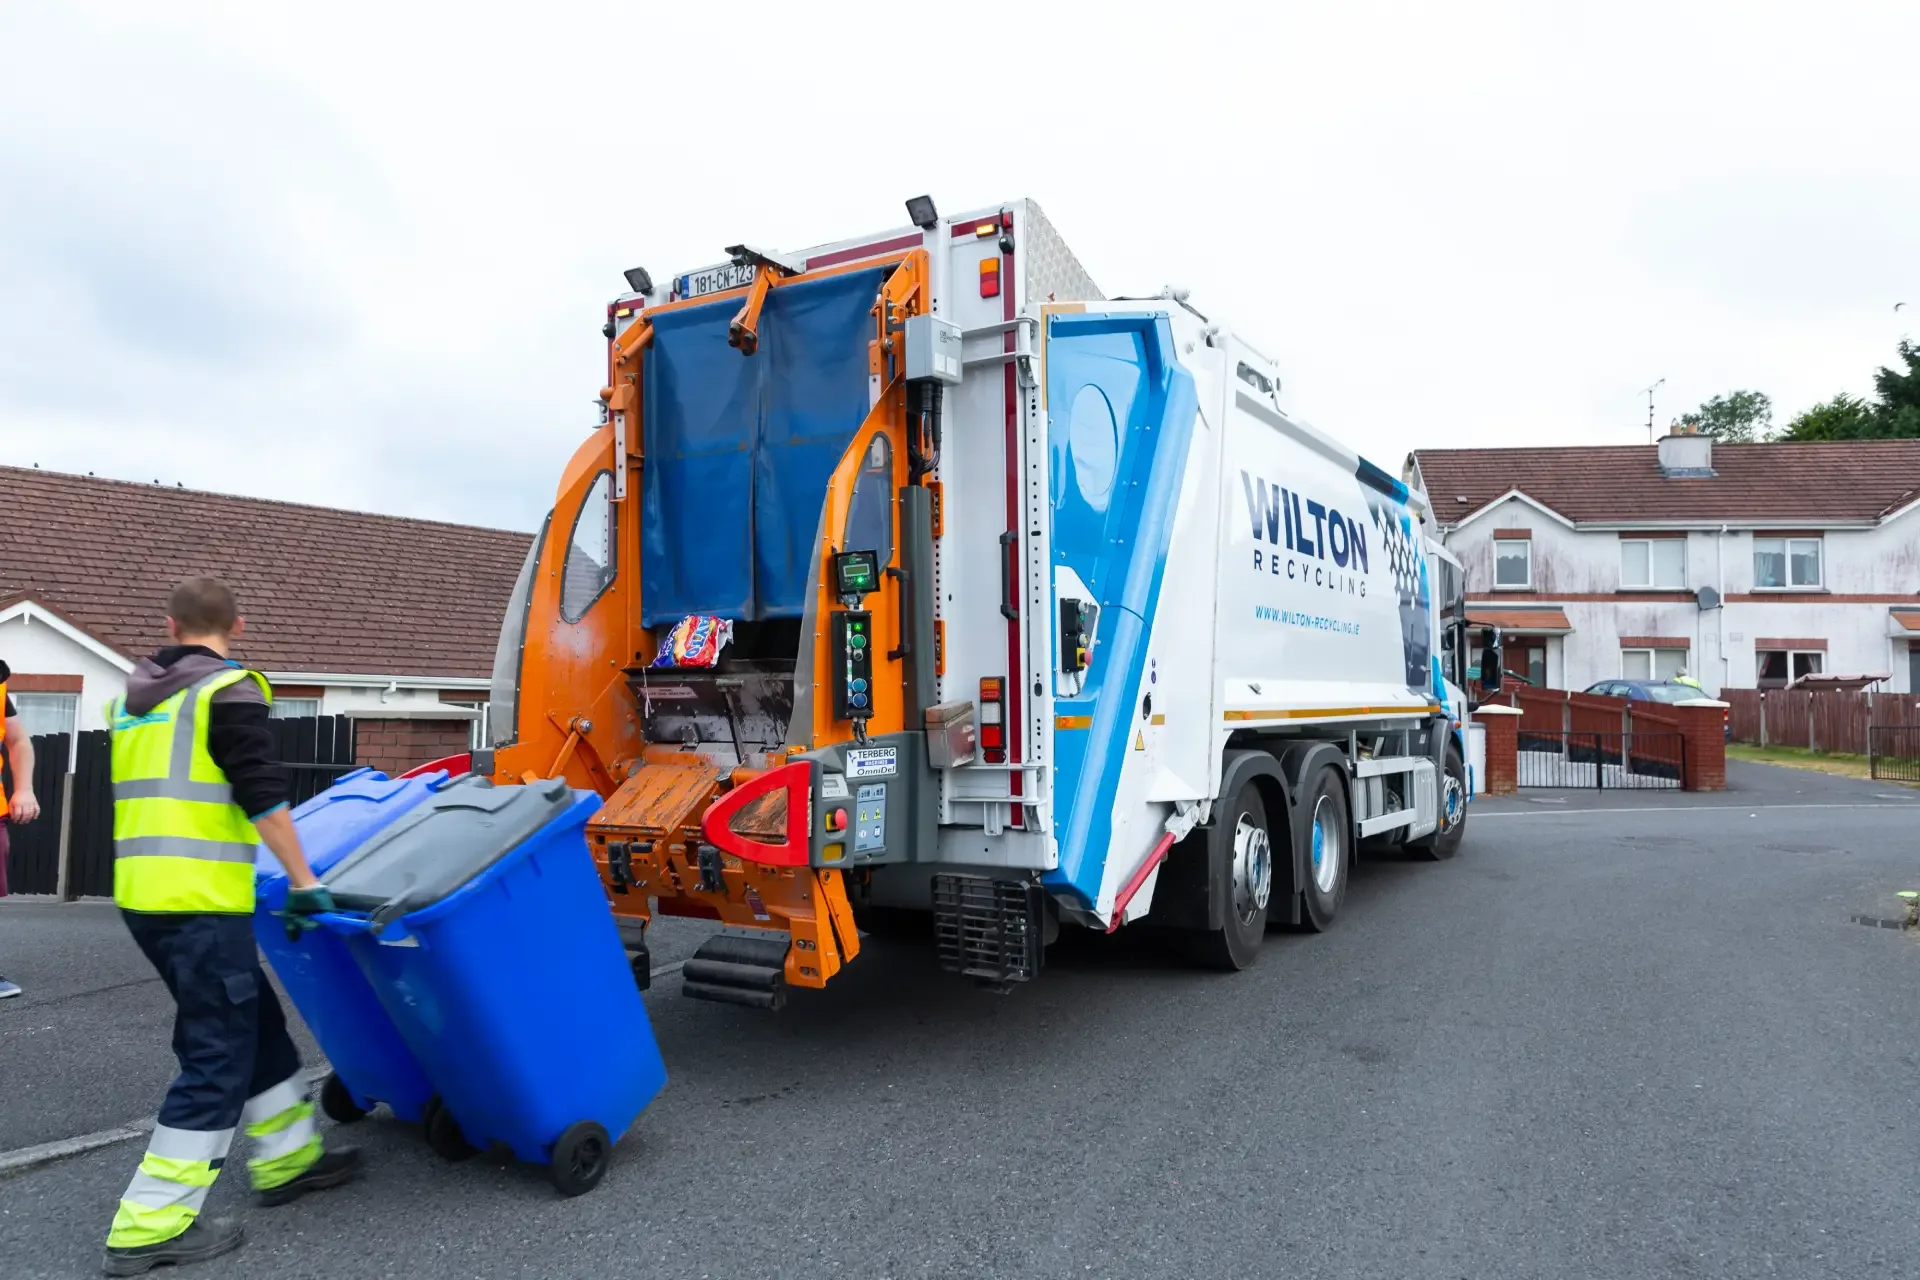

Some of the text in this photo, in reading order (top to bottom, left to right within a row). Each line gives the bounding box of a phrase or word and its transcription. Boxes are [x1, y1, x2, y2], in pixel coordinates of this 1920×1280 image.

[695, 264, 753, 294] 181-CN-123
[1241, 469, 1369, 574] WILTON
[1254, 549, 1366, 597] RECYCLING
[1255, 605, 1360, 635] WWW.WILTON-RECYCLING.IE
[684, 616, 711, 658] AYTO
[857, 749, 895, 759] TERBERG
[857, 766, 895, 775] OmniDel
